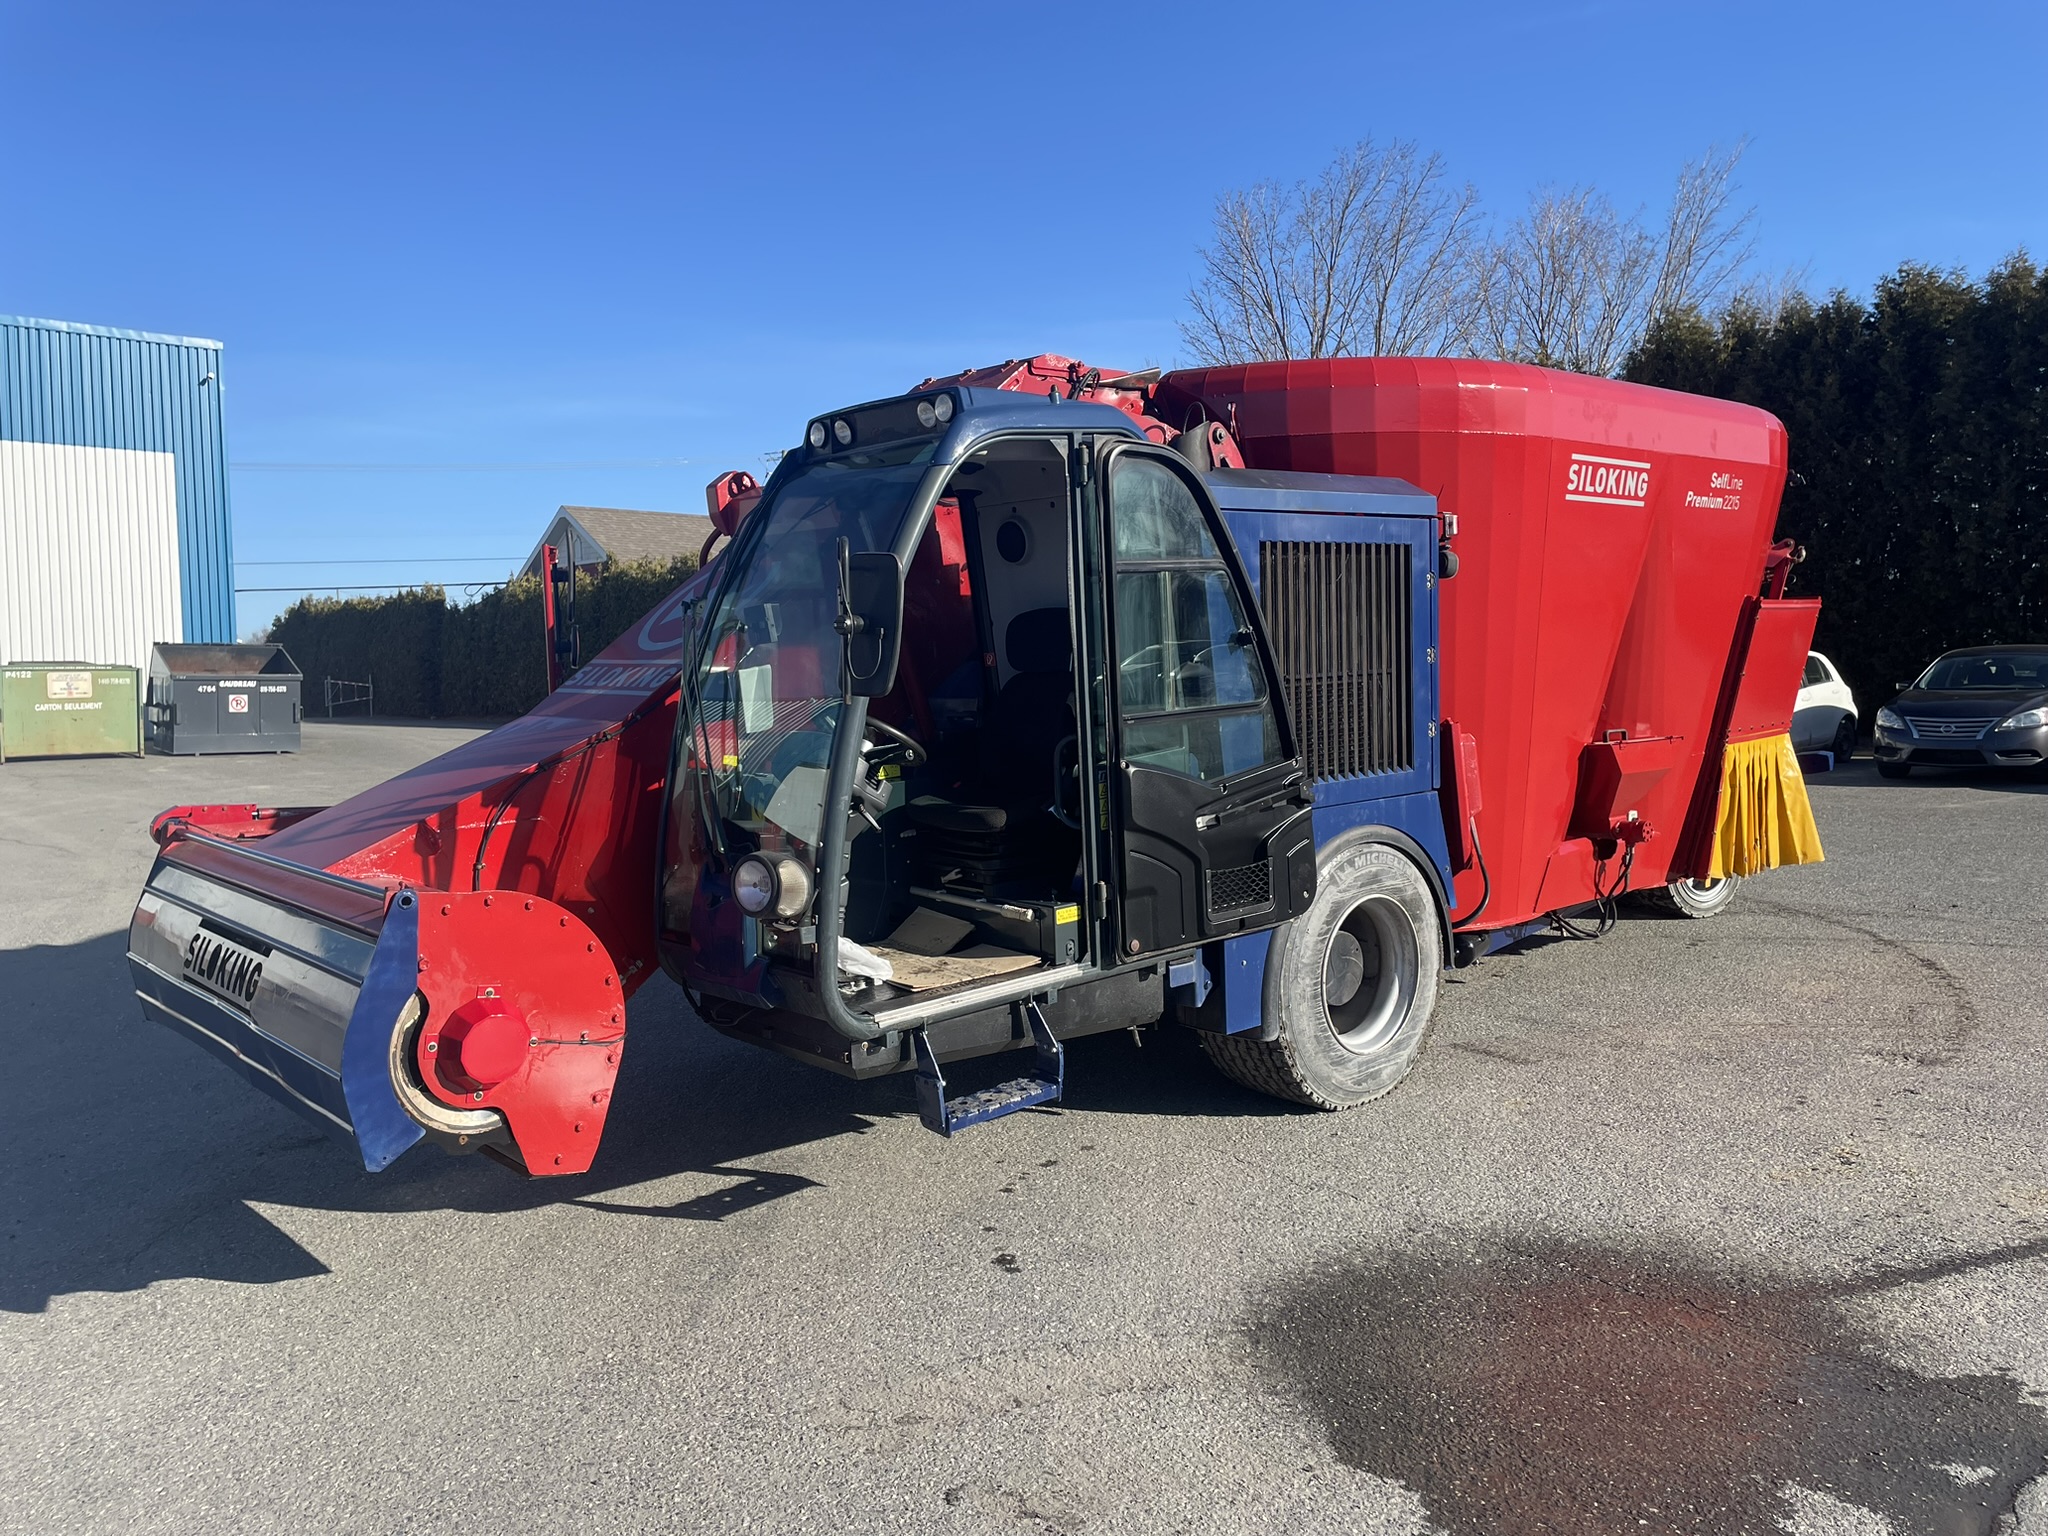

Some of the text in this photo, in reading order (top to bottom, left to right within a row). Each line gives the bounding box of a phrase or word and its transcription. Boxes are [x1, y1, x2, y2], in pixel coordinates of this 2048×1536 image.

[1567, 463, 1649, 498] SILOKING
[1710, 472, 1743, 491] SelfLine
[1684, 490, 1741, 510] Premium 2215
[5, 670, 32, 679] P4122
[218, 680, 257, 688] GAUDREAU
[564, 665, 678, 688] SILOKING
[34, 701, 103, 712] CARTON SEULEMENT
[184, 933, 263, 1002] SILOKING
